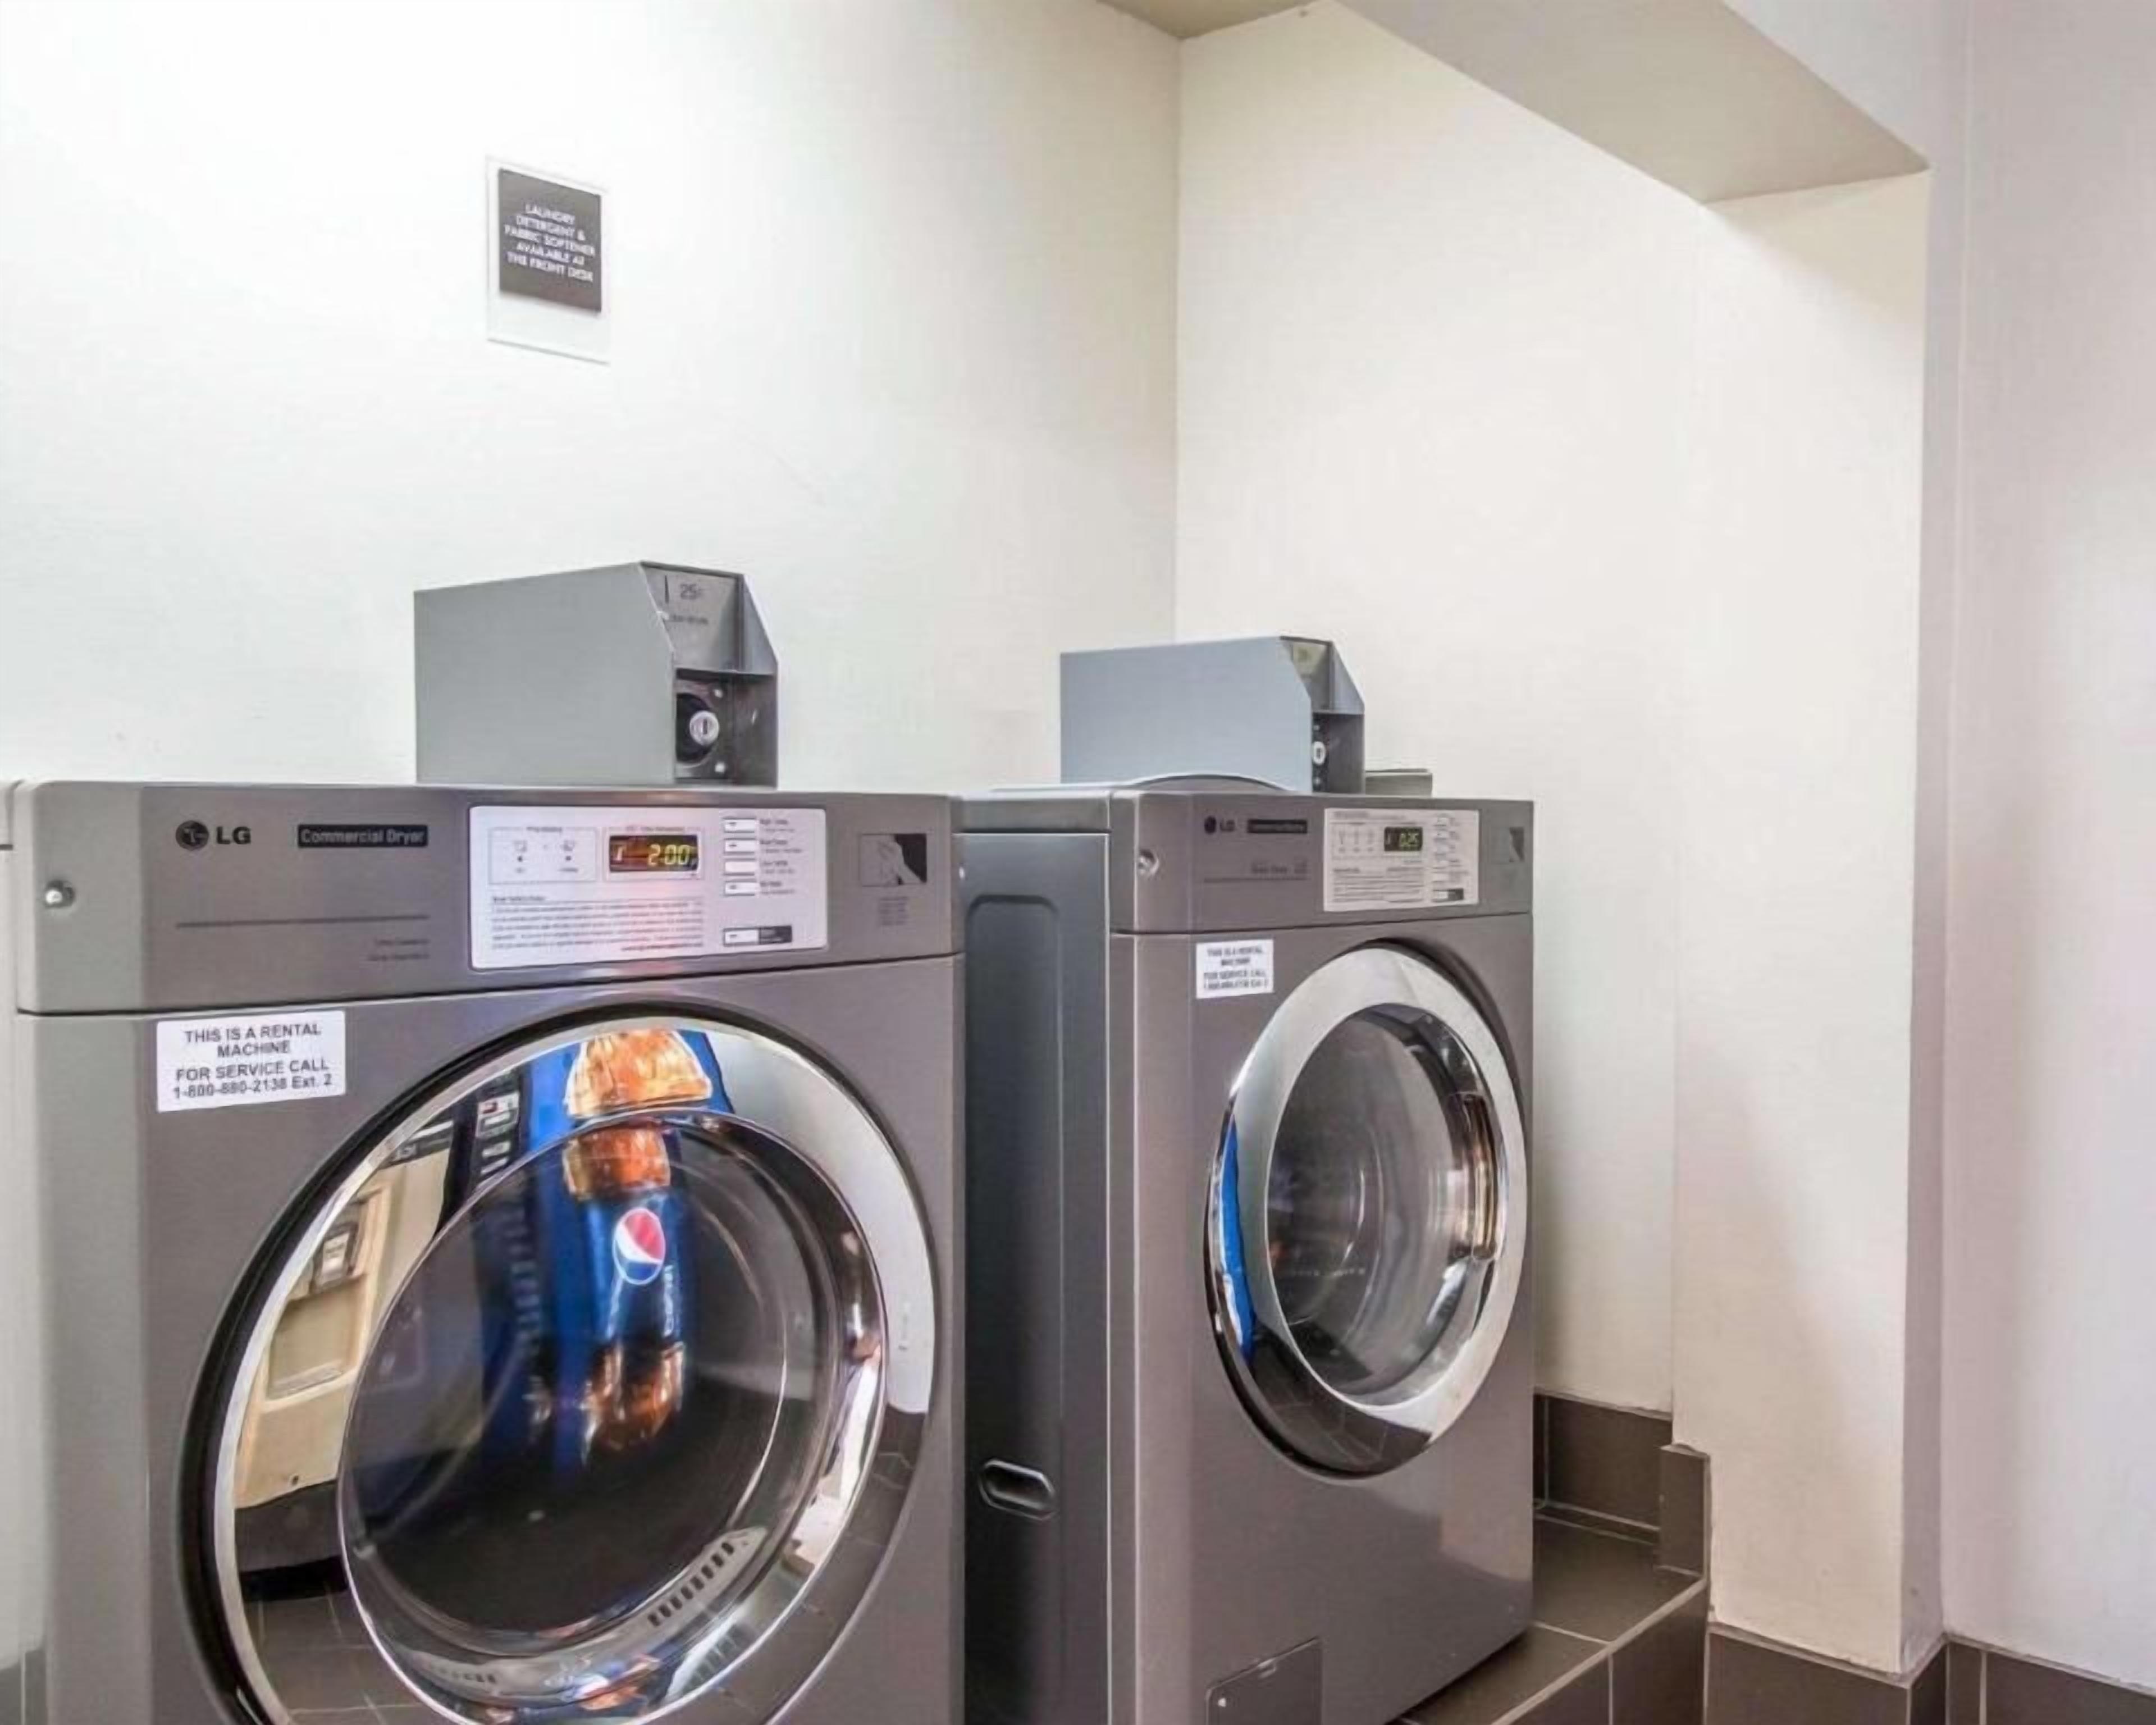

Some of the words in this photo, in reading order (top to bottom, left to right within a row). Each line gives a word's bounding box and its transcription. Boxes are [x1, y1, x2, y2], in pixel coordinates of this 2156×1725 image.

[216, 827, 251, 845] LG
[301, 829, 384, 843] Commercial
[185, 1028, 221, 1043] THIS
[226, 1028, 241, 1041] IS
[245, 1026, 257, 1039] A
[260, 1024, 322, 1038] RENTAL
[217, 1039, 291, 1058] MACHINE
[176, 1067, 211, 1081] FOR
[216, 1061, 284, 1079] SERVICE
[290, 1057, 330, 1071] CALL
[323, 1073, 332, 1085] 2
